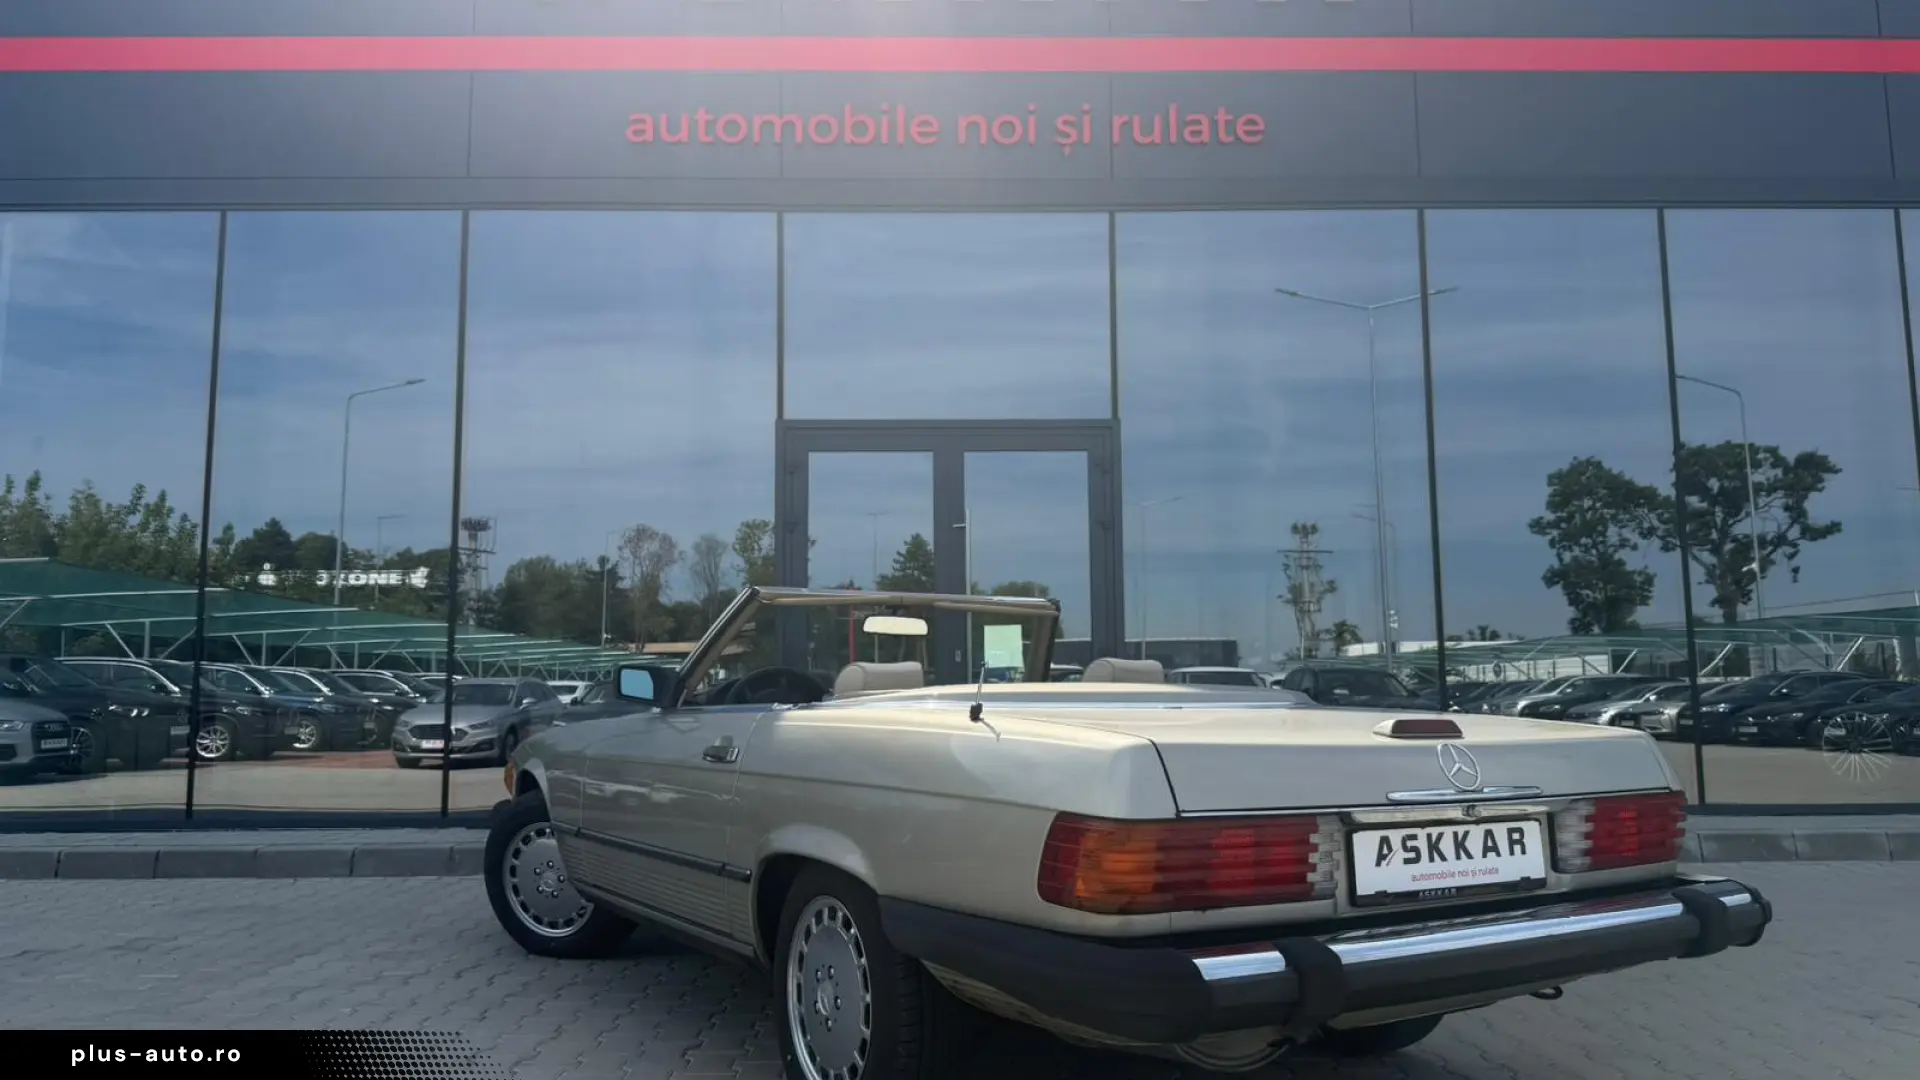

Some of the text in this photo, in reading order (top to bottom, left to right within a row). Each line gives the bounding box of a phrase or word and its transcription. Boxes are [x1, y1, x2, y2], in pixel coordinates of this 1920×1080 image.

[625, 103, 1266, 157] automobile noi și rulate
[1374, 827, 1527, 868] ASKKAR
[1411, 868, 1456, 882] automobile
[1457, 867, 1470, 878] noi
[1478, 865, 1499, 877] rulate
